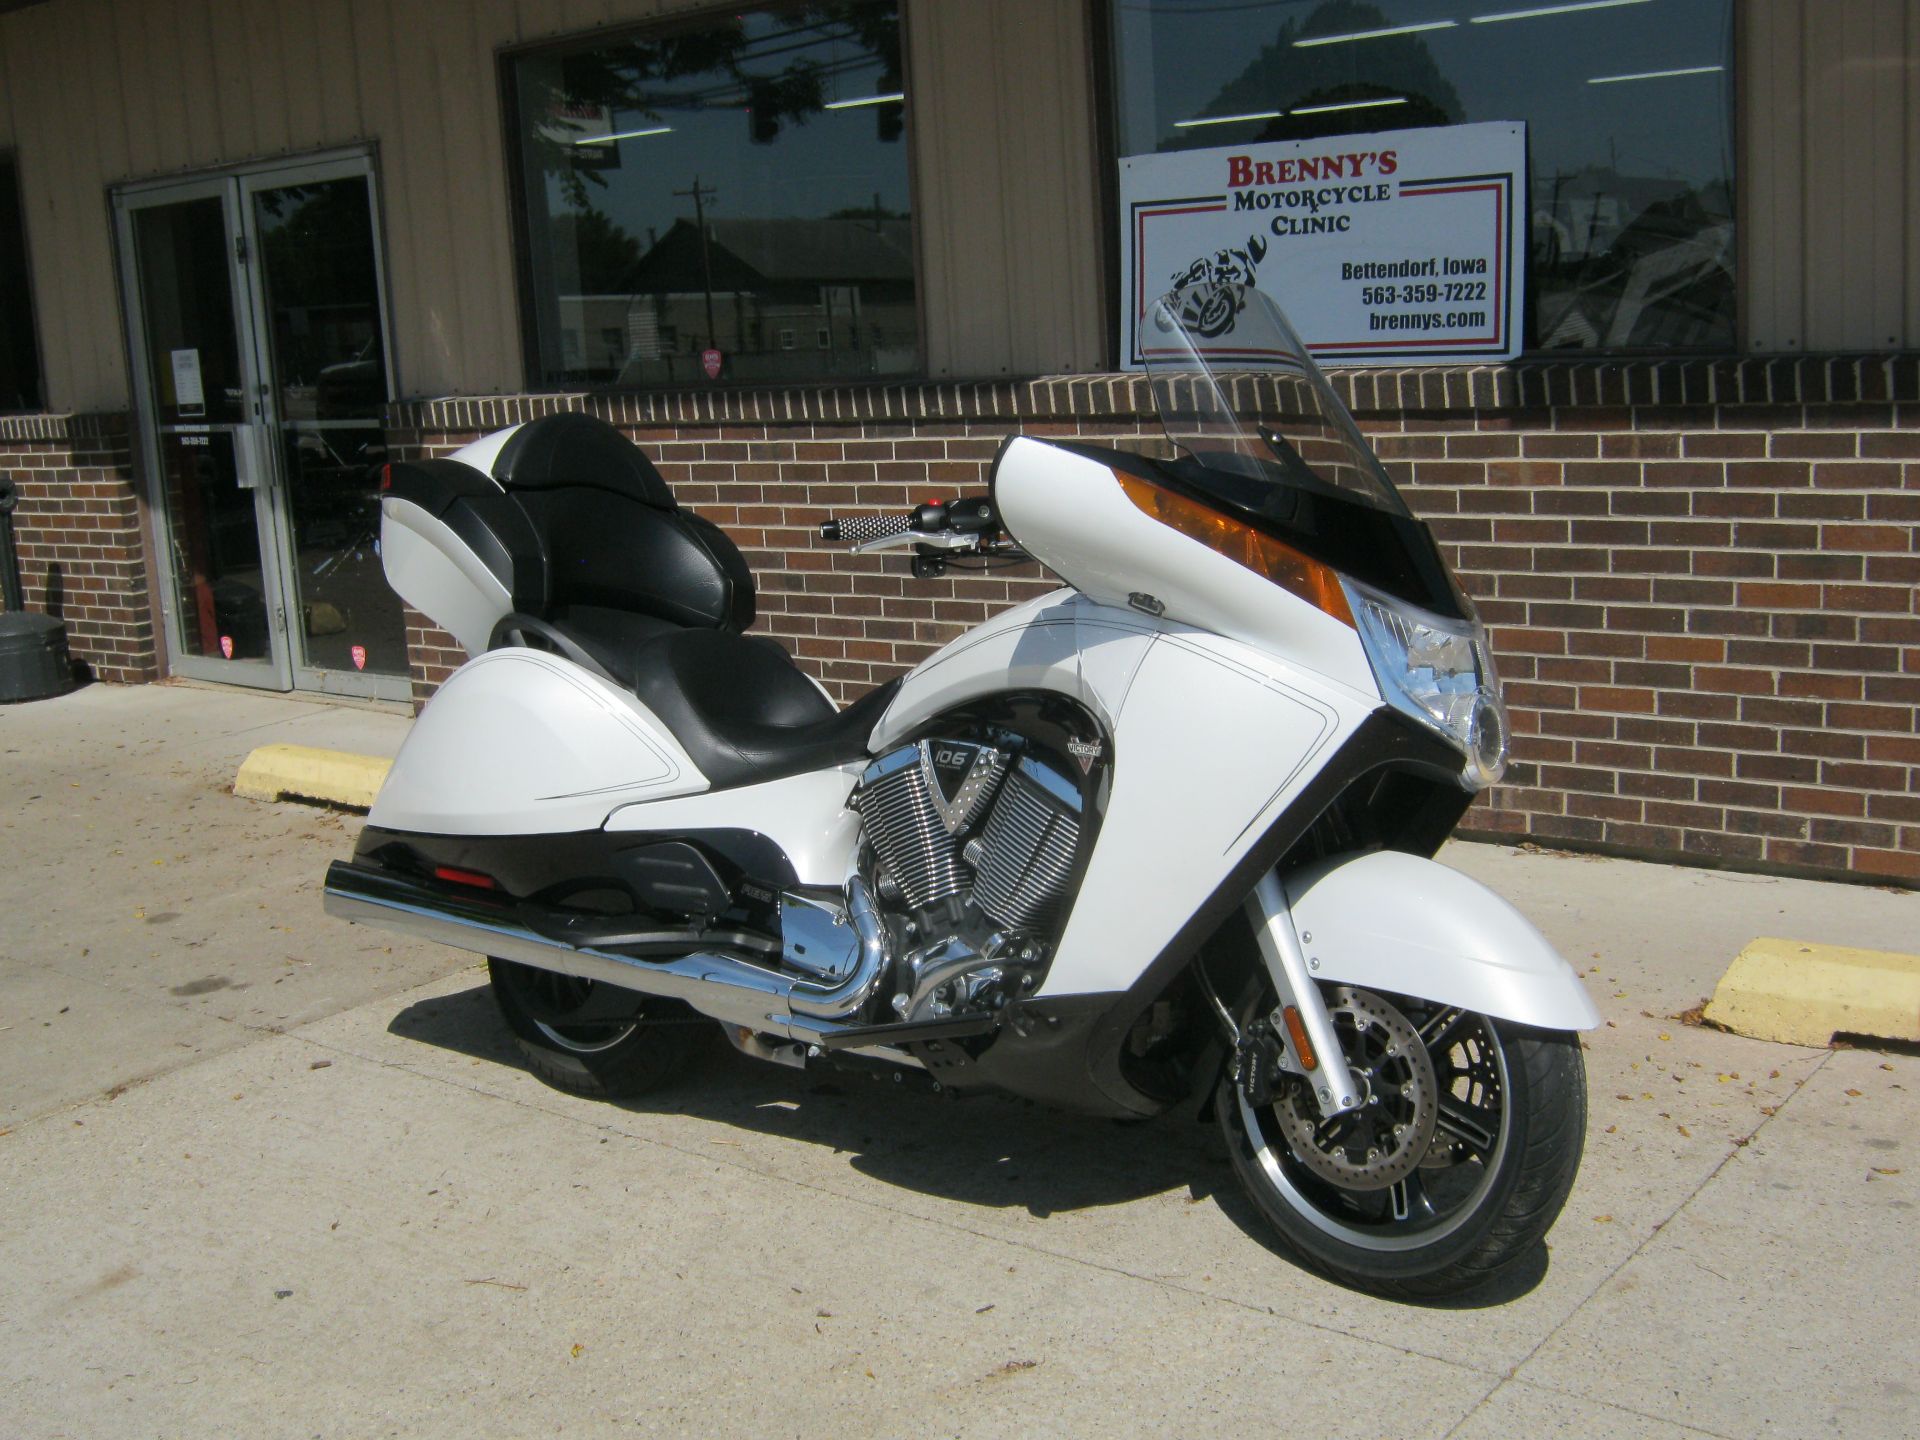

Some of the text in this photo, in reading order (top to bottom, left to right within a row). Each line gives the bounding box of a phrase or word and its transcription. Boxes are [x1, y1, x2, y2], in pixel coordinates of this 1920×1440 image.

[1227, 150, 1398, 187] BRENNY'S
[1234, 184, 1391, 213] MOTORCYCLE
[1270, 215, 1350, 236] CLINIC
[1341, 257, 1487, 281] Bettendorf, Iowa
[1362, 282, 1486, 306] 563-359-7222
[1369, 310, 1486, 331] brennys.com
[935, 750, 969, 765] 106
[1066, 743, 1102, 757] VICTORY
[1248, 1052, 1257, 1094] VICTORY
